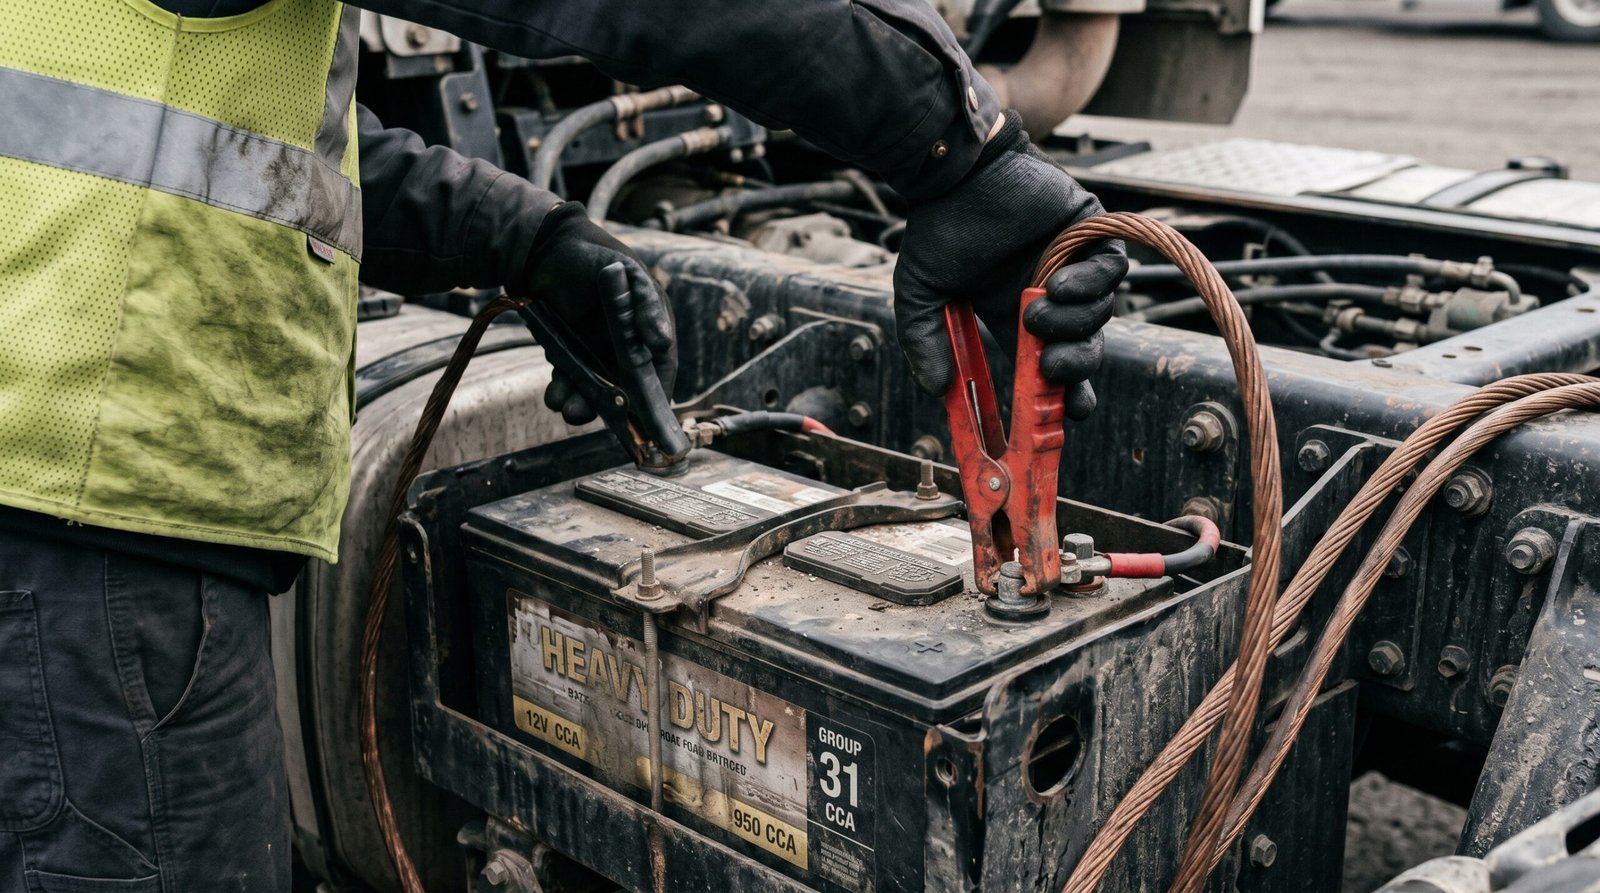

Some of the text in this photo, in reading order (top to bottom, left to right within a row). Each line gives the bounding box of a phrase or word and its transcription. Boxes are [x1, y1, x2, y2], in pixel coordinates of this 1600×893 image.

[541, 625, 774, 764] HEAVY DUTY
[526, 709, 581, 750] 12V CCA
[818, 726, 863, 757] GROUP
[819, 751, 859, 808] 31
[734, 809, 797, 856] 950 CCA
[825, 802, 856, 832] CCA
